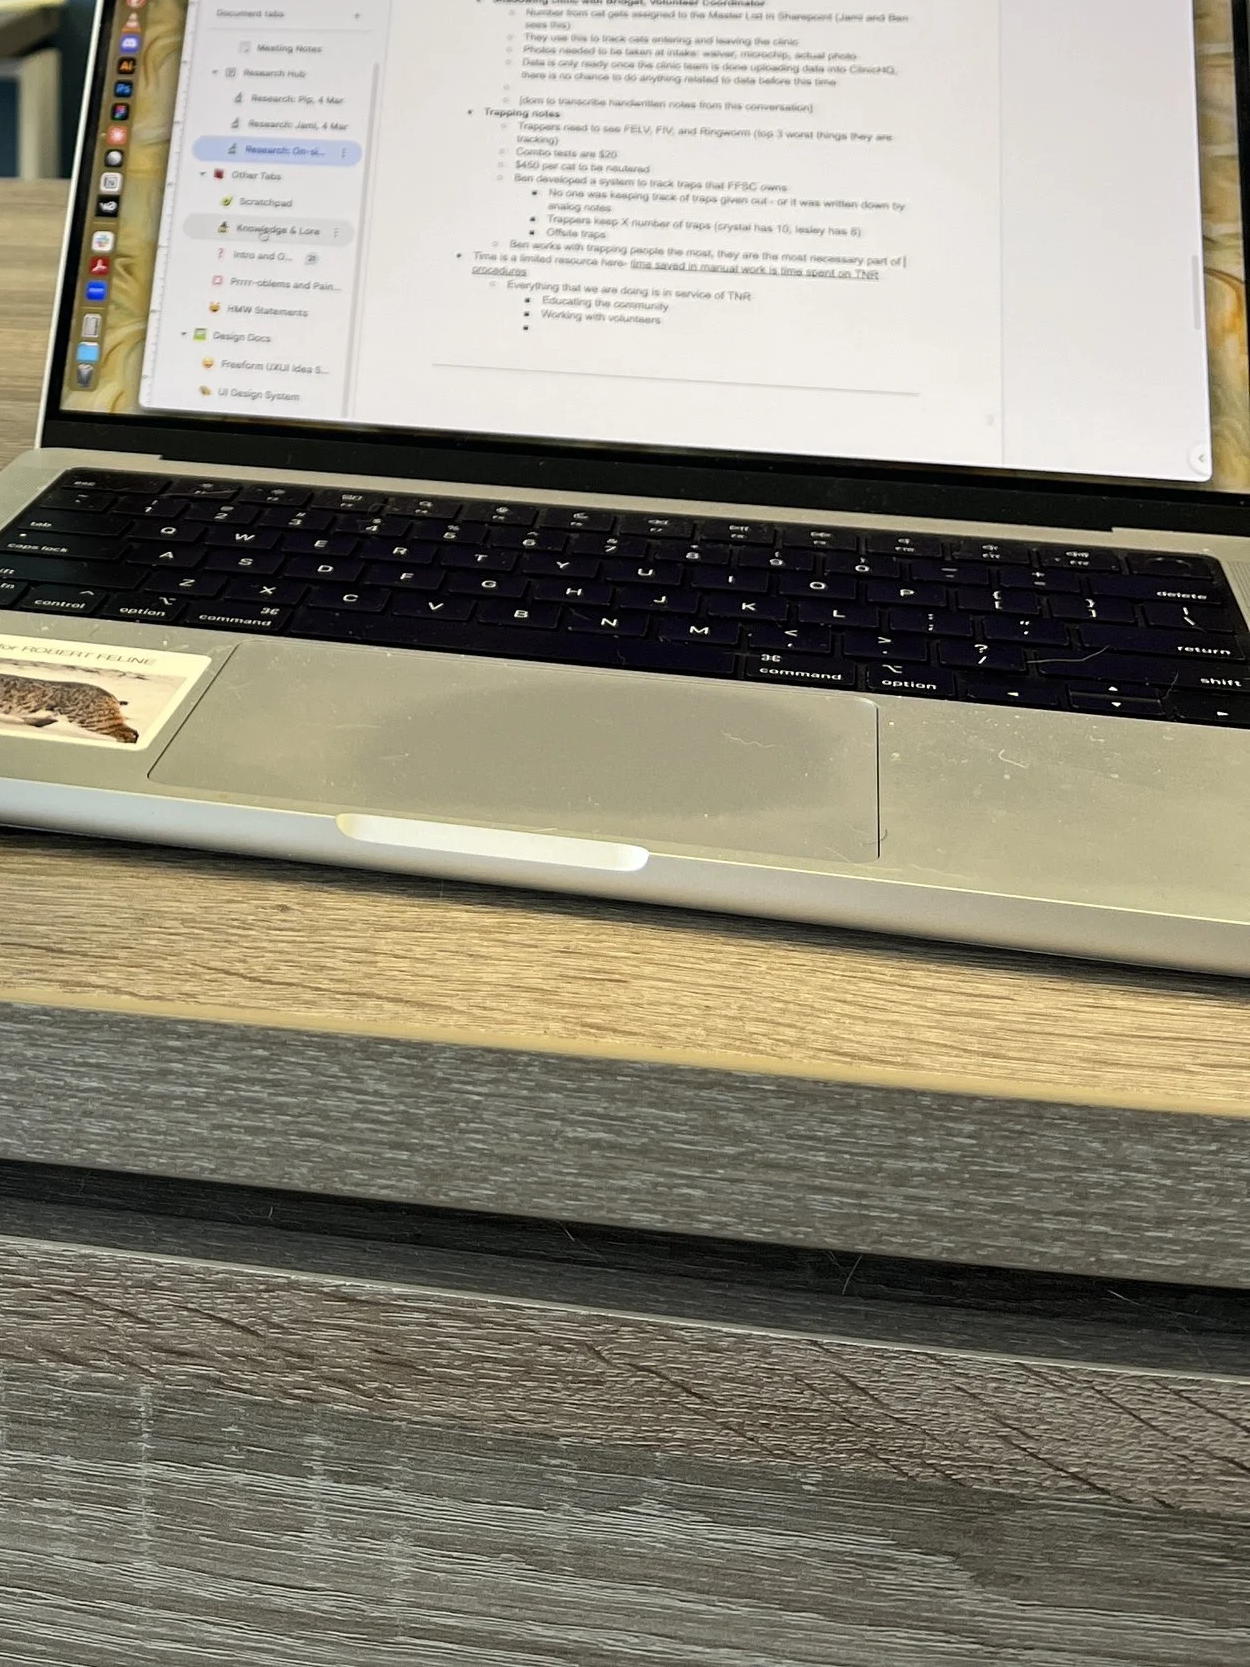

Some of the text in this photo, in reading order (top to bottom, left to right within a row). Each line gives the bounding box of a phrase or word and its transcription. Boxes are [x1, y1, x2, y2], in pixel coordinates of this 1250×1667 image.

[256, 44, 322, 54] Meeting Notes
[243, 69, 306, 78] Research Hub
[484, 107, 561, 119] Trapping notes
[516, 146, 551, 156] Combo
[553, 148, 576, 157] tests
[541, 163, 558, 172] per
[560, 162, 575, 170] cat
[578, 162, 588, 171] to
[590, 162, 603, 171] be
[605, 163, 650, 173] neutered
[232, 171, 282, 180] Other Tabs
[514, 173, 533, 182] Ben
[536, 174, 587, 186] developed
[598, 176, 634, 188] system
[636, 177, 646, 186] to
[649, 178, 674, 188] track
[676, 179, 702, 190] traps
[704, 180, 724, 190] that
[760, 184, 788, 192] owns
[239, 197, 292, 209] Scratchpad
[548, 202, 612, 213] analog notes
[580, 229, 606, 240] traps
[510, 239, 529, 248] Ben
[532, 240, 561, 250] works
[563, 242, 584, 251] with
[586, 243, 627, 255] trapping
[629, 245, 664, 257] people
[666, 246, 683, 256] the
[716, 249, 739, 260] they
[762, 251, 778, 260] the
[781, 252, 806, 262] most
[809, 255, 863, 266] necessary
[866, 256, 888, 267] part
[890, 257, 901, 266] of
[542, 295, 669, 312] Educating the community
[227, 305, 308, 316] HMW Statements
[540, 309, 662, 324] Working with volunteers
[213, 331, 272, 343] Design Docs
[230, 389, 262, 400] Design
[264, 390, 300, 402] System
[160, 526, 177, 535] Q
[235, 533, 255, 541] W
[7, 542, 69, 553] caps lock
[314, 539, 328, 548] E
[159, 551, 174, 559] A
[392, 546, 408, 555] R
[238, 558, 253, 566] S
[476, 554, 487, 562] T
[318, 564, 334, 573] D
[556, 561, 570, 569] Y
[400, 572, 414, 580] F
[638, 568, 654, 576] U
[179, 578, 196, 587] Z
[481, 580, 497, 588] G
[810, 581, 827, 590] O
[259, 586, 276, 595] X
[566, 588, 582, 596] H
[899, 589, 915, 597] P
[342, 594, 359, 602] C
[654, 595, 667, 603] J
[1156, 591, 1207, 600] delete
[34, 599, 86, 609] control
[428, 602, 444, 611] V
[741, 602, 756, 611] K
[119, 607, 166, 617] option
[513, 609, 529, 618] B
[833, 609, 845, 618] L
[198, 613, 272, 627] command
[601, 618, 618, 627] N
[689, 626, 709, 635] M
[22, 645, 92, 658] ROBERT
[96, 653, 156, 665] FELINE
[1177, 646, 1231, 655] return
[759, 667, 842, 681] command
[881, 679, 937, 690] option
[1200, 677, 1242, 687] shift
